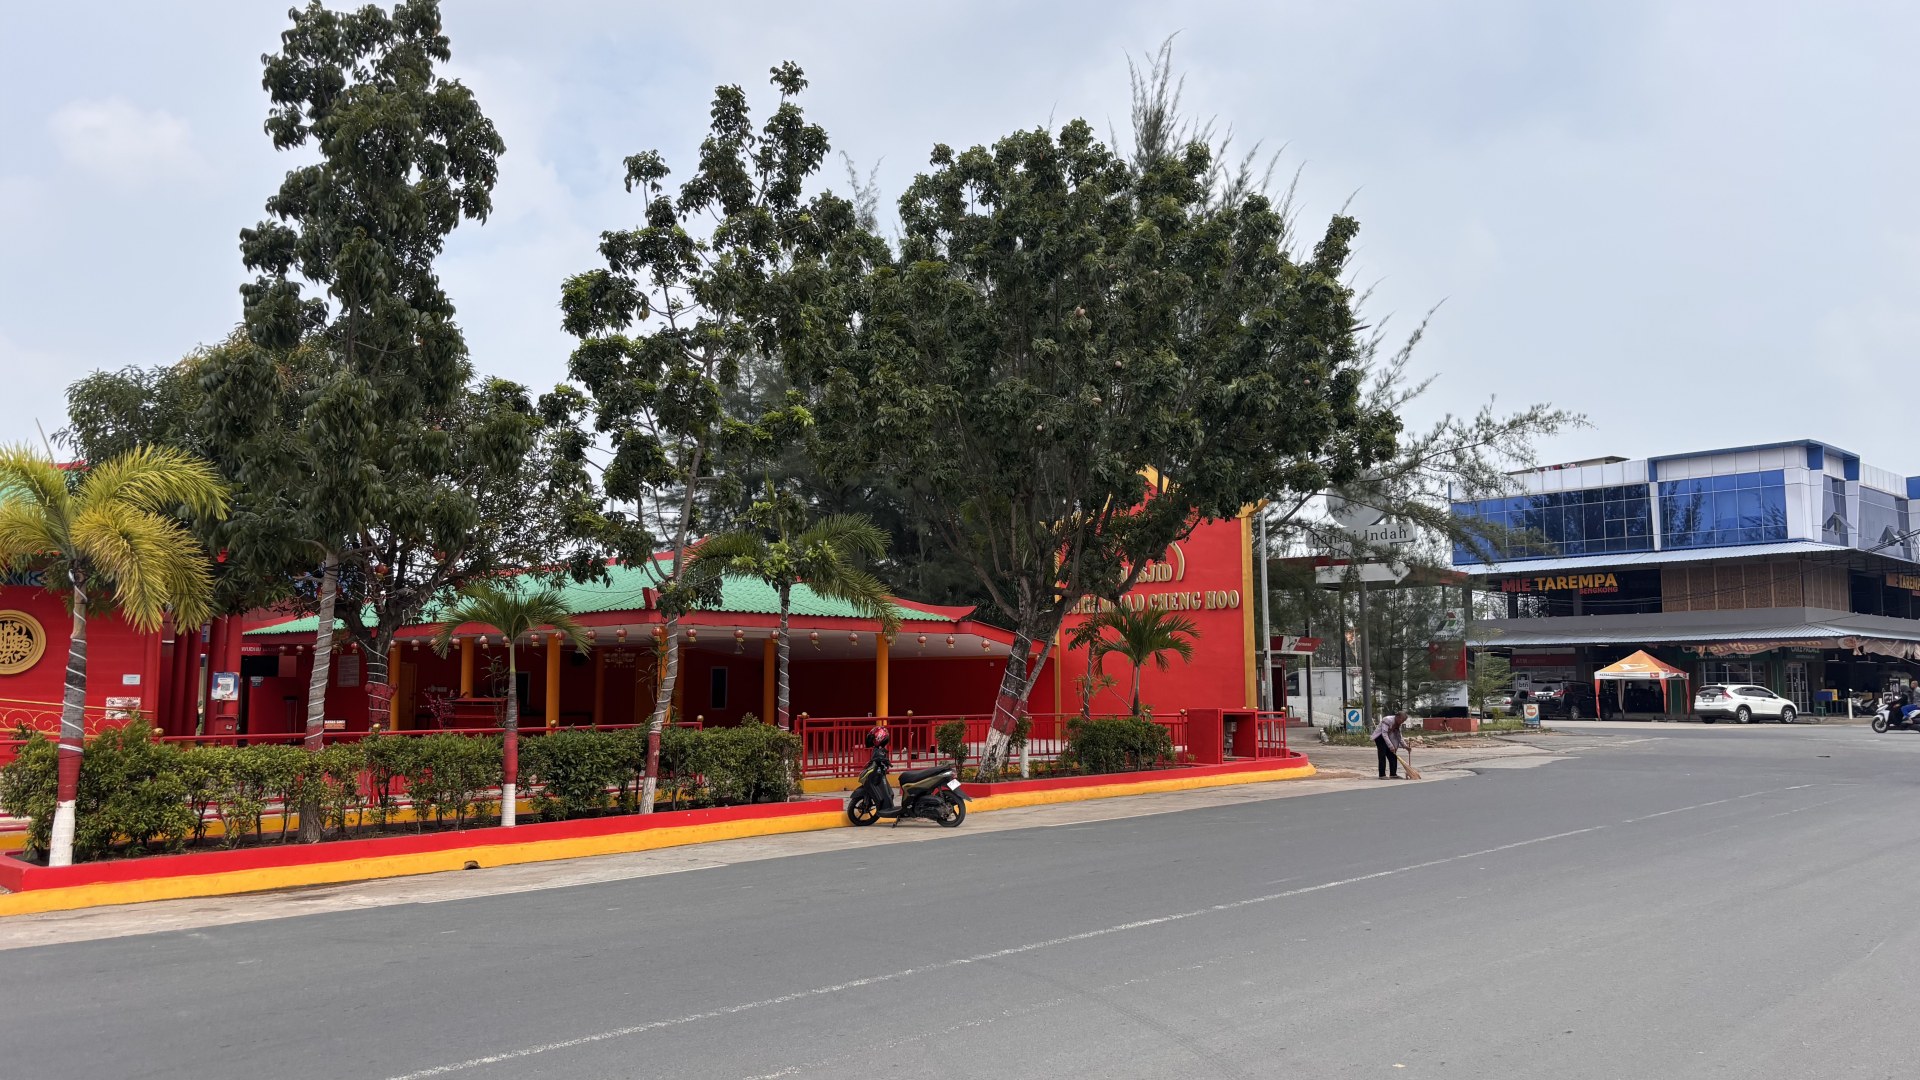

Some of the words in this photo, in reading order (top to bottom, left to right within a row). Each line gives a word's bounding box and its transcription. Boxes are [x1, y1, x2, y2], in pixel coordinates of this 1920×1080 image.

[1364, 526, 1407, 541] Indah
[1117, 564, 1173, 583] MSJID
[1501, 578, 1531, 592] MIE
[1534, 573, 1618, 591] TAREMPA
[1580, 586, 1618, 594] BENGKONG
[1065, 593, 1146, 615] UHMAD
[1149, 591, 1201, 611] CHENG
[1204, 590, 1240, 610] HOO
